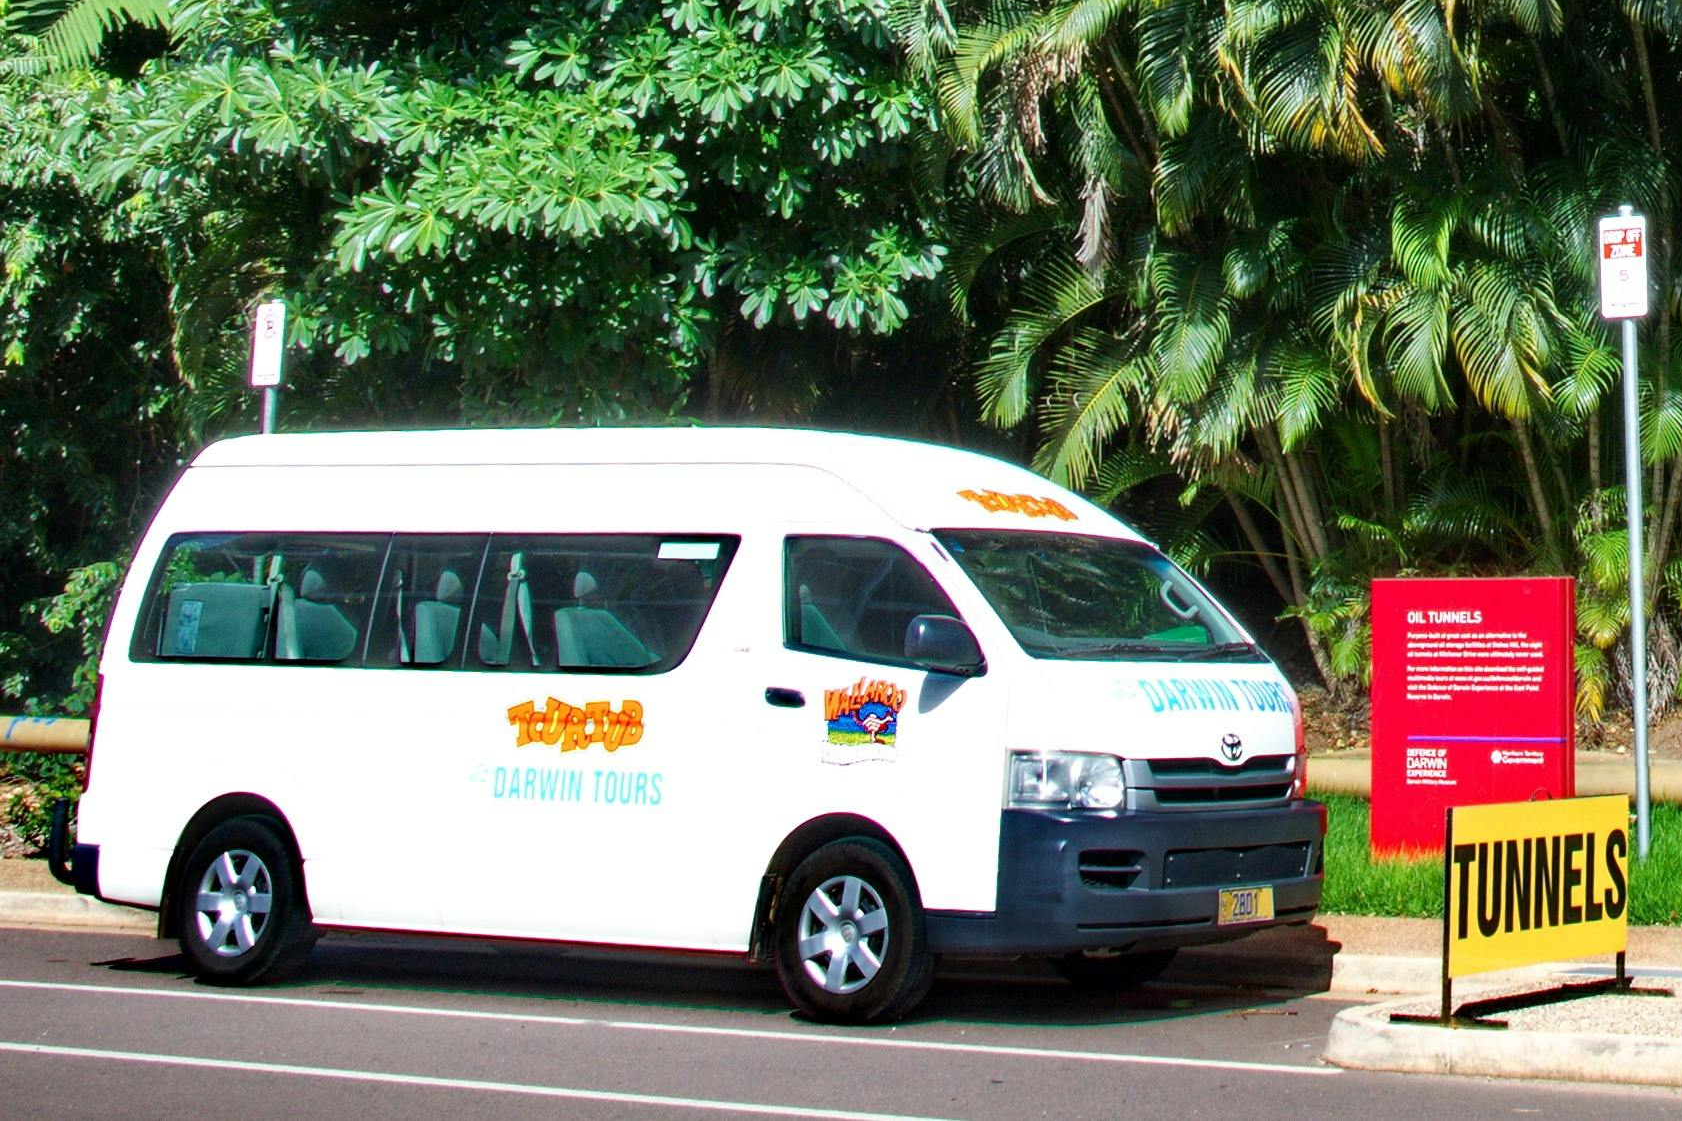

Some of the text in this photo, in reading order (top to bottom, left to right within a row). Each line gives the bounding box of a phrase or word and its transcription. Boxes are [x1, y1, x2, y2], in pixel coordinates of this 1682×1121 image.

[1407, 610, 1482, 624] OIL TUNNELS
[824, 676, 907, 721] WALLAROO
[1137, 678, 1295, 714] DARWIN TOURS
[1407, 748, 1447, 757] DEFENCE OF
[1407, 757, 1447, 769] DARWIN
[493, 765, 664, 806] DARWIN TOURS
[1407, 769, 1447, 778] EXPERIENCE
[1453, 828, 1627, 941] TUNNELS
[1233, 892, 1257, 916] 2801
